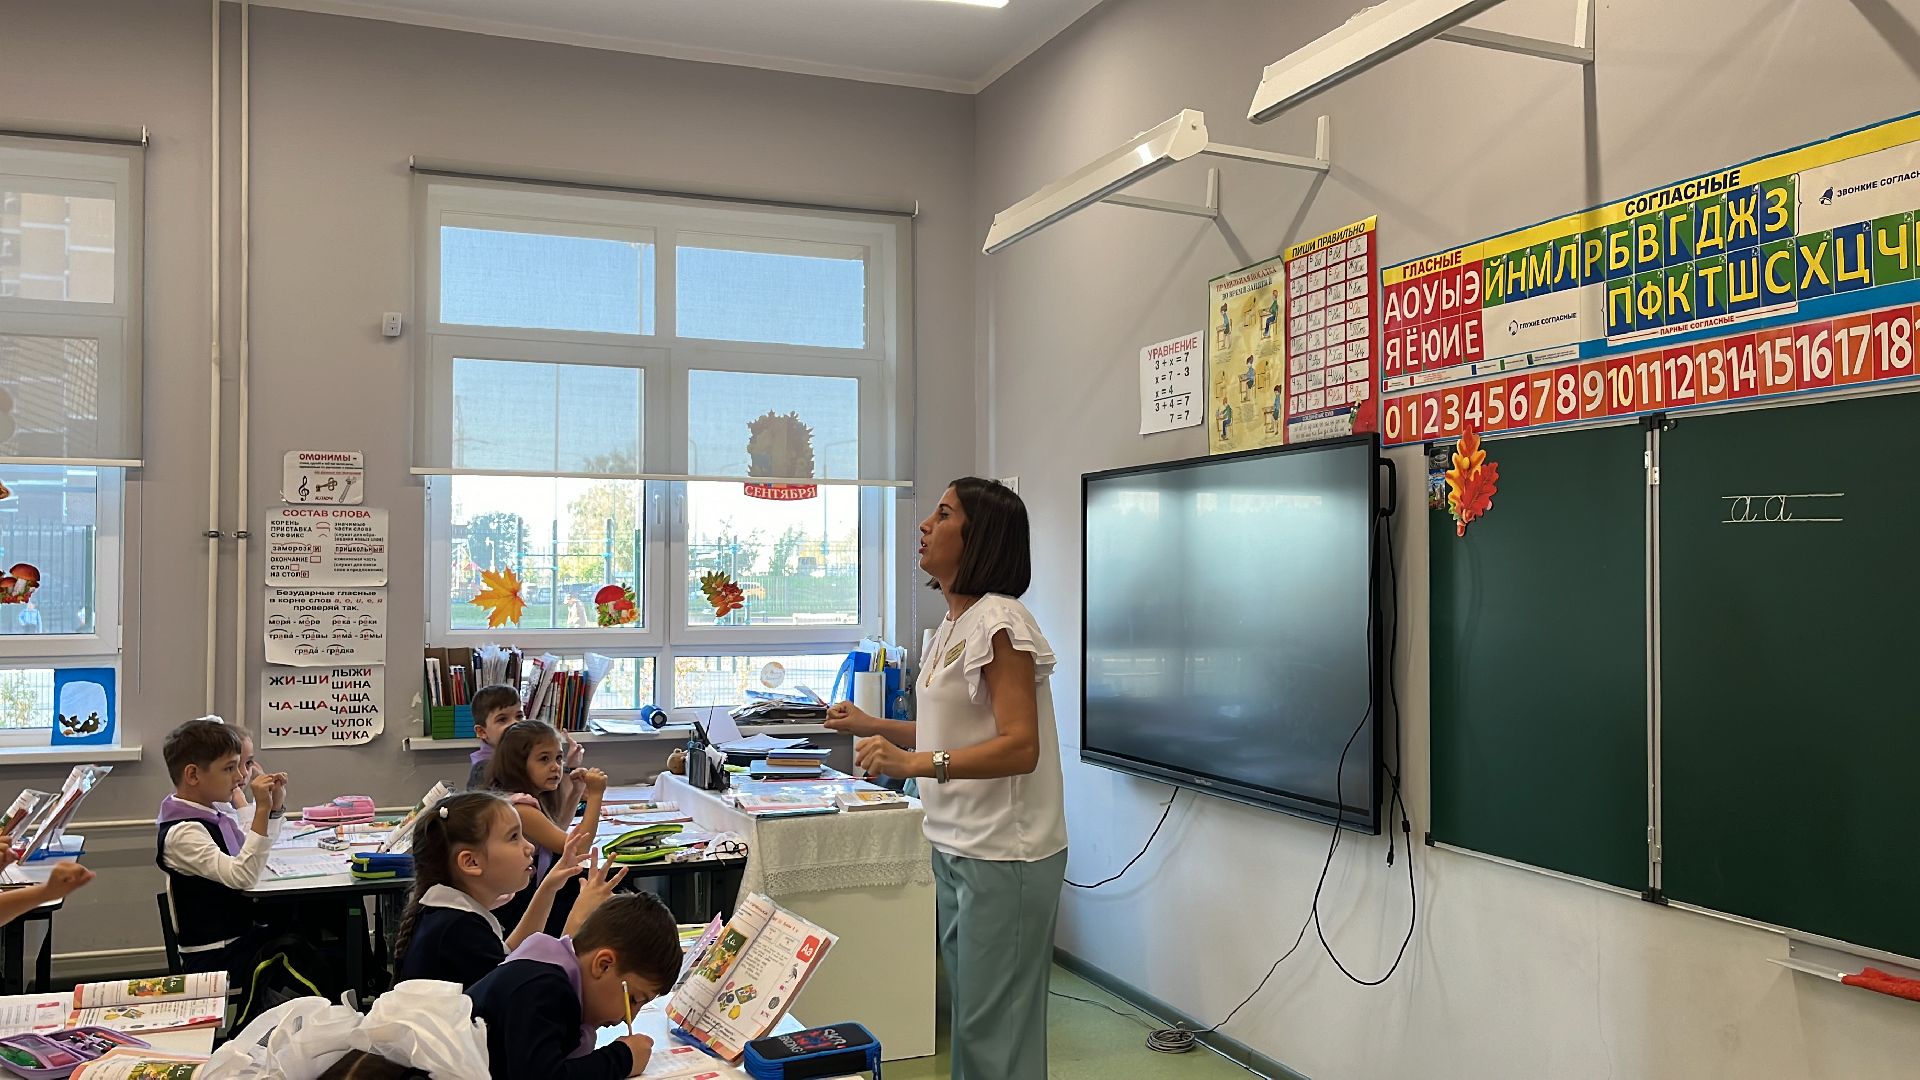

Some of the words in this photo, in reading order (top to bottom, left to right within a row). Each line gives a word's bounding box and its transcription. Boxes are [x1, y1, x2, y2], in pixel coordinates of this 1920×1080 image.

[1625, 170, 1741, 217] СОГЛАСНЫЕ
[1837, 181, 1878, 198] ЗВОНКИЕ
[1292, 241, 1316, 258] ПИШИ
[1317, 222, 1366, 248] ПРАВИЛЬНО
[1402, 251, 1462, 279] ГЛАСНЫЕ
[1519, 319, 1540, 330] ГЛУХИЕ
[1541, 312, 1577, 325] СОГЛАСНЫЕ
[1660, 323, 1689, 336] ПАРНЫЕ
[1690, 315, 1735, 330] СОГЛАСНЫЕ
[1148, 337, 1198, 361] УРАВНЕНИЕ
[1155, 360, 1160, 370] 3
[1184, 352, 1190, 362] 7
[1169, 371, 1173, 380] 7
[1184, 366, 1190, 376] 3
[1385, 405, 1400, 439] 0
[1407, 401, 1417, 436] 1
[1423, 397, 1439, 435] 2
[1443, 394, 1460, 431] 3
[1464, 390, 1483, 428] 4
[1487, 386, 1505, 425] 5
[1509, 381, 1528, 421] 6
[1532, 378, 1551, 419] 7
[1556, 373, 1577, 415] 8
[1582, 370, 1604, 411] 9
[1607, 364, 1634, 408] 10
[1636, 360, 1662, 405] 11
[1664, 354, 1695, 400] 12
[1696, 349, 1726, 396] 13
[1727, 344, 1756, 392] 14
[1758, 337, 1793, 386] 15
[1796, 330, 1833, 382] 16
[1834, 324, 1871, 377] 17
[1874, 317, 1913, 371] 18
[1168, 385, 1173, 395] 4
[1155, 402, 1160, 412] 3
[1169, 399, 1174, 408] 4
[1184, 396, 1190, 406] 7
[1170, 413, 1174, 423] 7
[1184, 410, 1190, 420] 7
[299, 453, 351, 462] ОМОНИМЫ
[744, 485, 816, 499] СЕНТЯБРЯ
[282, 509, 329, 518] СОСТАВ
[332, 510, 371, 519] СЛОВА
[332, 669, 371, 677] ЛЫЖИ
[269, 675, 329, 685] ЖИ-ШИ
[332, 681, 371, 689] ШИНА
[332, 693, 370, 702] ЧАЩА
[269, 701, 328, 710] ЧА-ЩА
[330, 705, 378, 714] ЧАШКА
[332, 718, 372, 727] ЧУЛОК
[269, 726, 328, 736] ЧУ-ЩУ
[332, 731, 369, 741] ЩУКА
[801, 944, 814, 956] Аа
